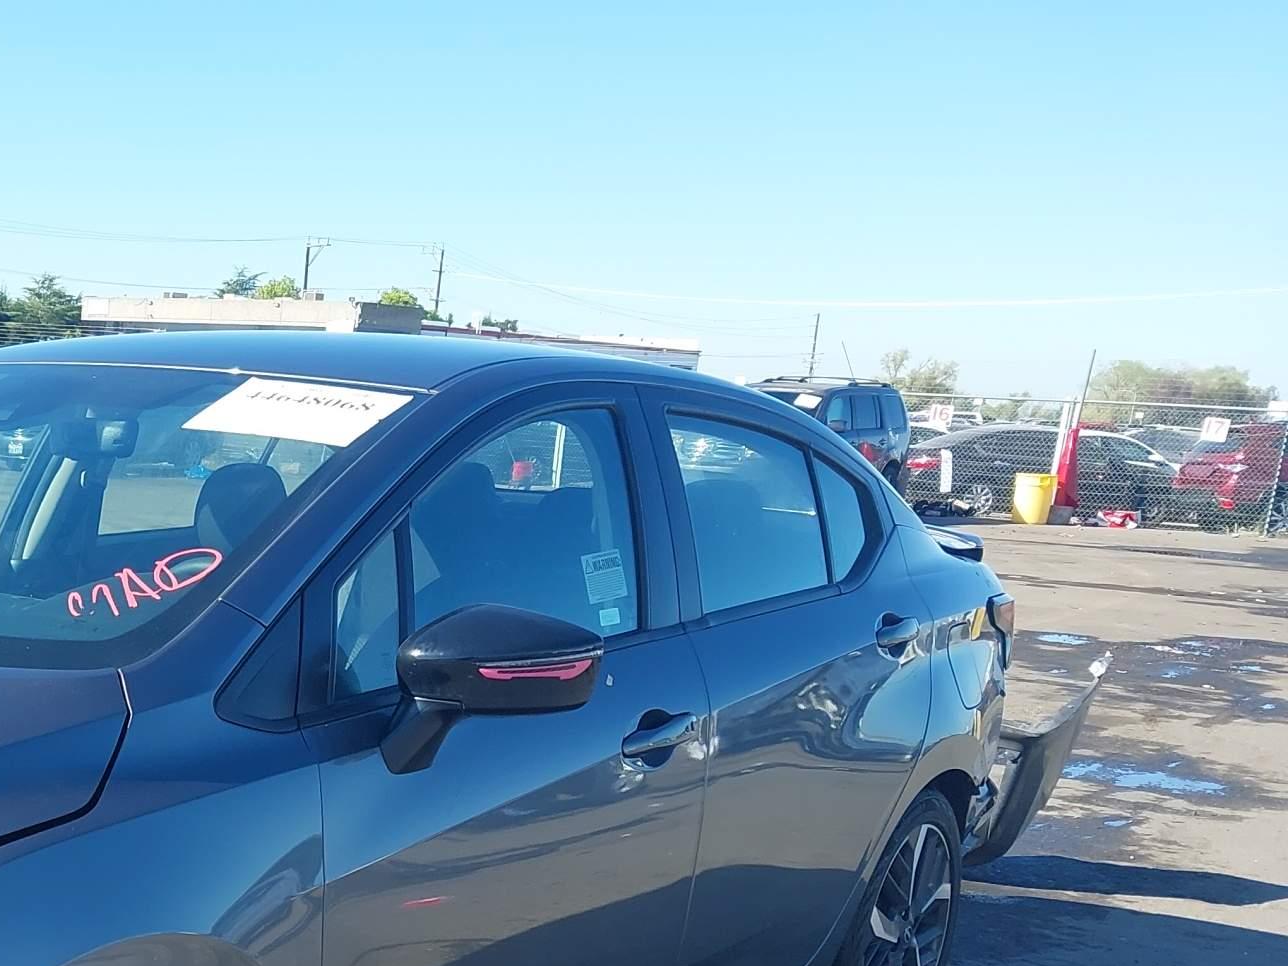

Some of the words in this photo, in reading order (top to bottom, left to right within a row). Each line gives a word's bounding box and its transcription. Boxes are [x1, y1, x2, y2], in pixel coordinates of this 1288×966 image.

[246, 390, 376, 412] 44648068
[931, 406, 951, 423] 16
[1205, 418, 1226, 436] 17
